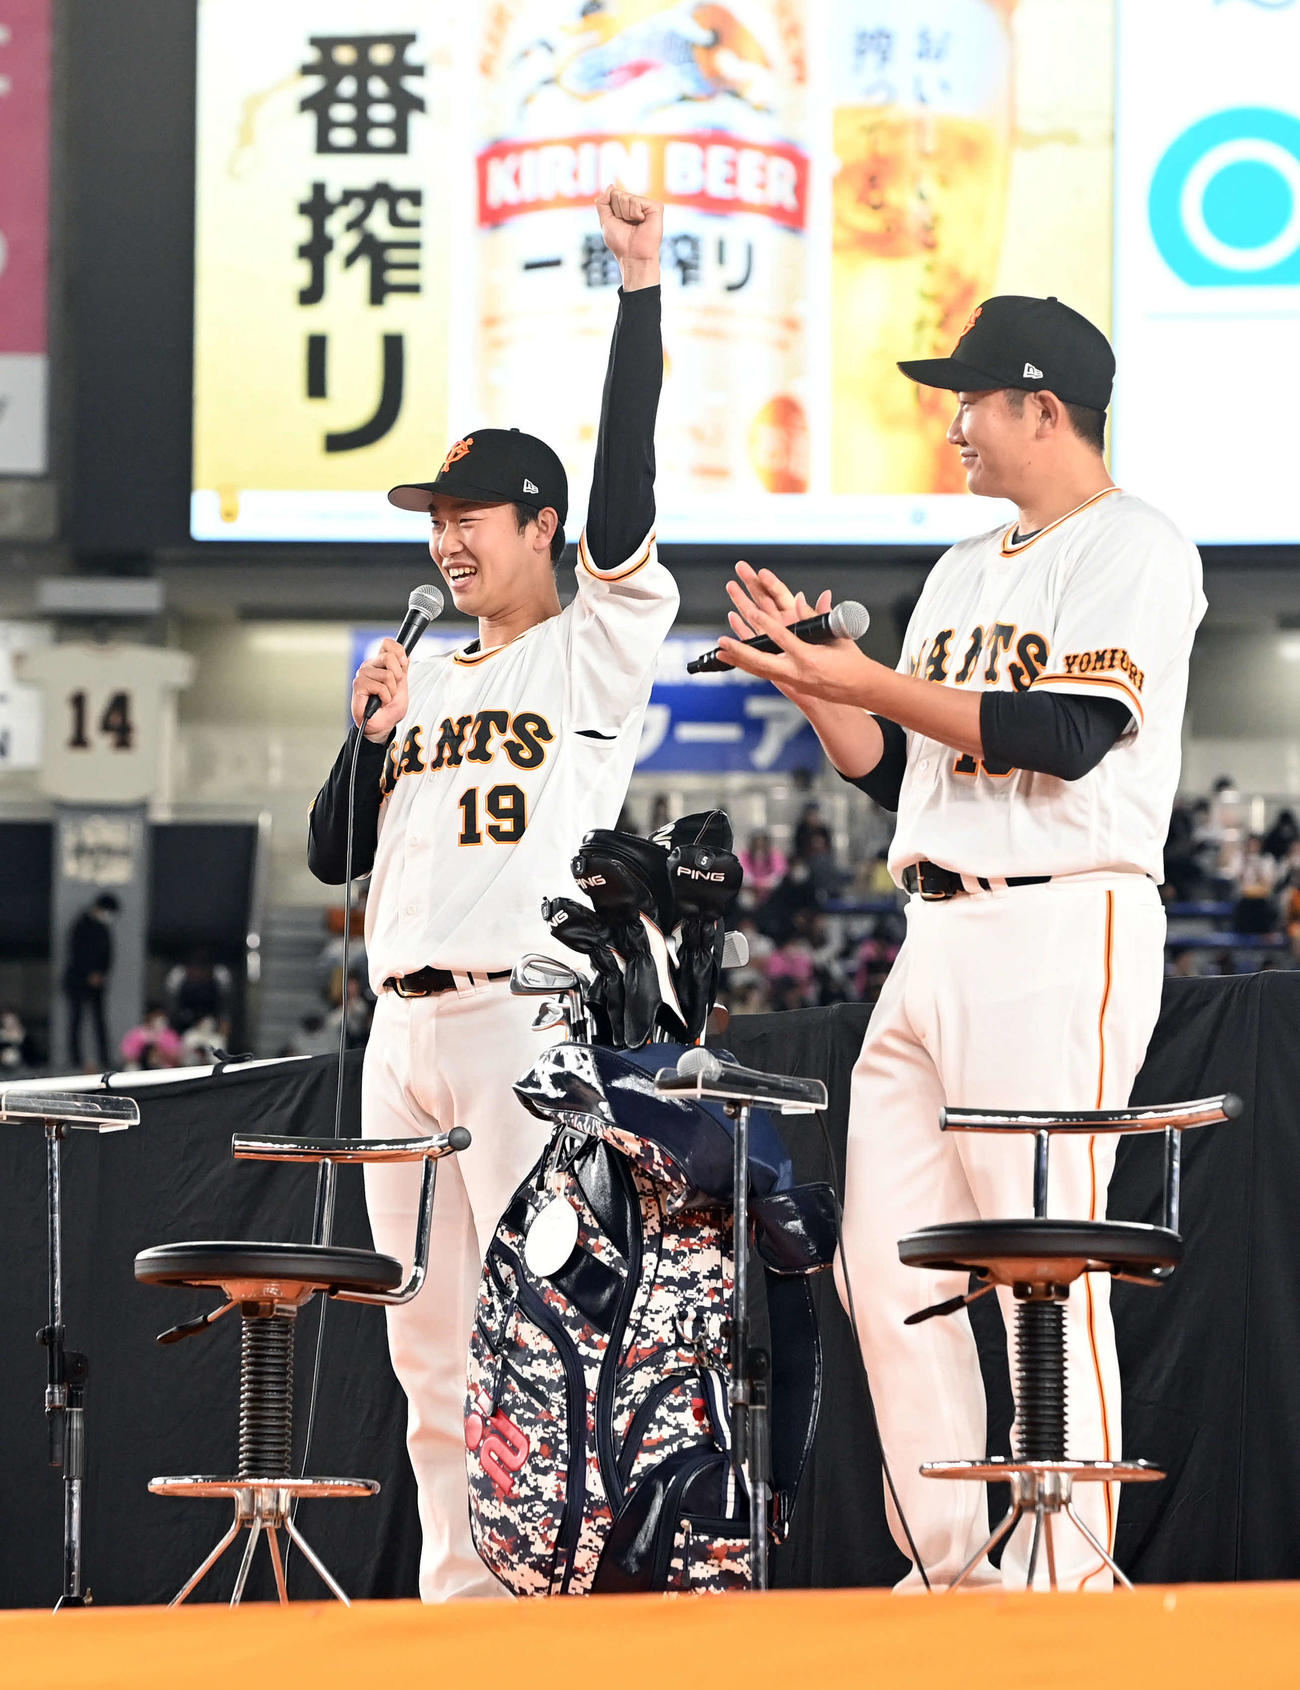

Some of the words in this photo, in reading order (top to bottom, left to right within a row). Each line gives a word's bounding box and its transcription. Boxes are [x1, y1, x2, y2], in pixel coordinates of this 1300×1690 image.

[486, 141, 649, 208] KIRIN
[664, 141, 799, 212] BEER
[297, 33, 427, 454] 番搾り
[1063, 647, 1145, 694] YOMIURI
[67, 689, 134, 750] 14
[458, 783, 529, 847] 19
[676, 865, 726, 883] PING
[700, 855, 709, 866] 5
